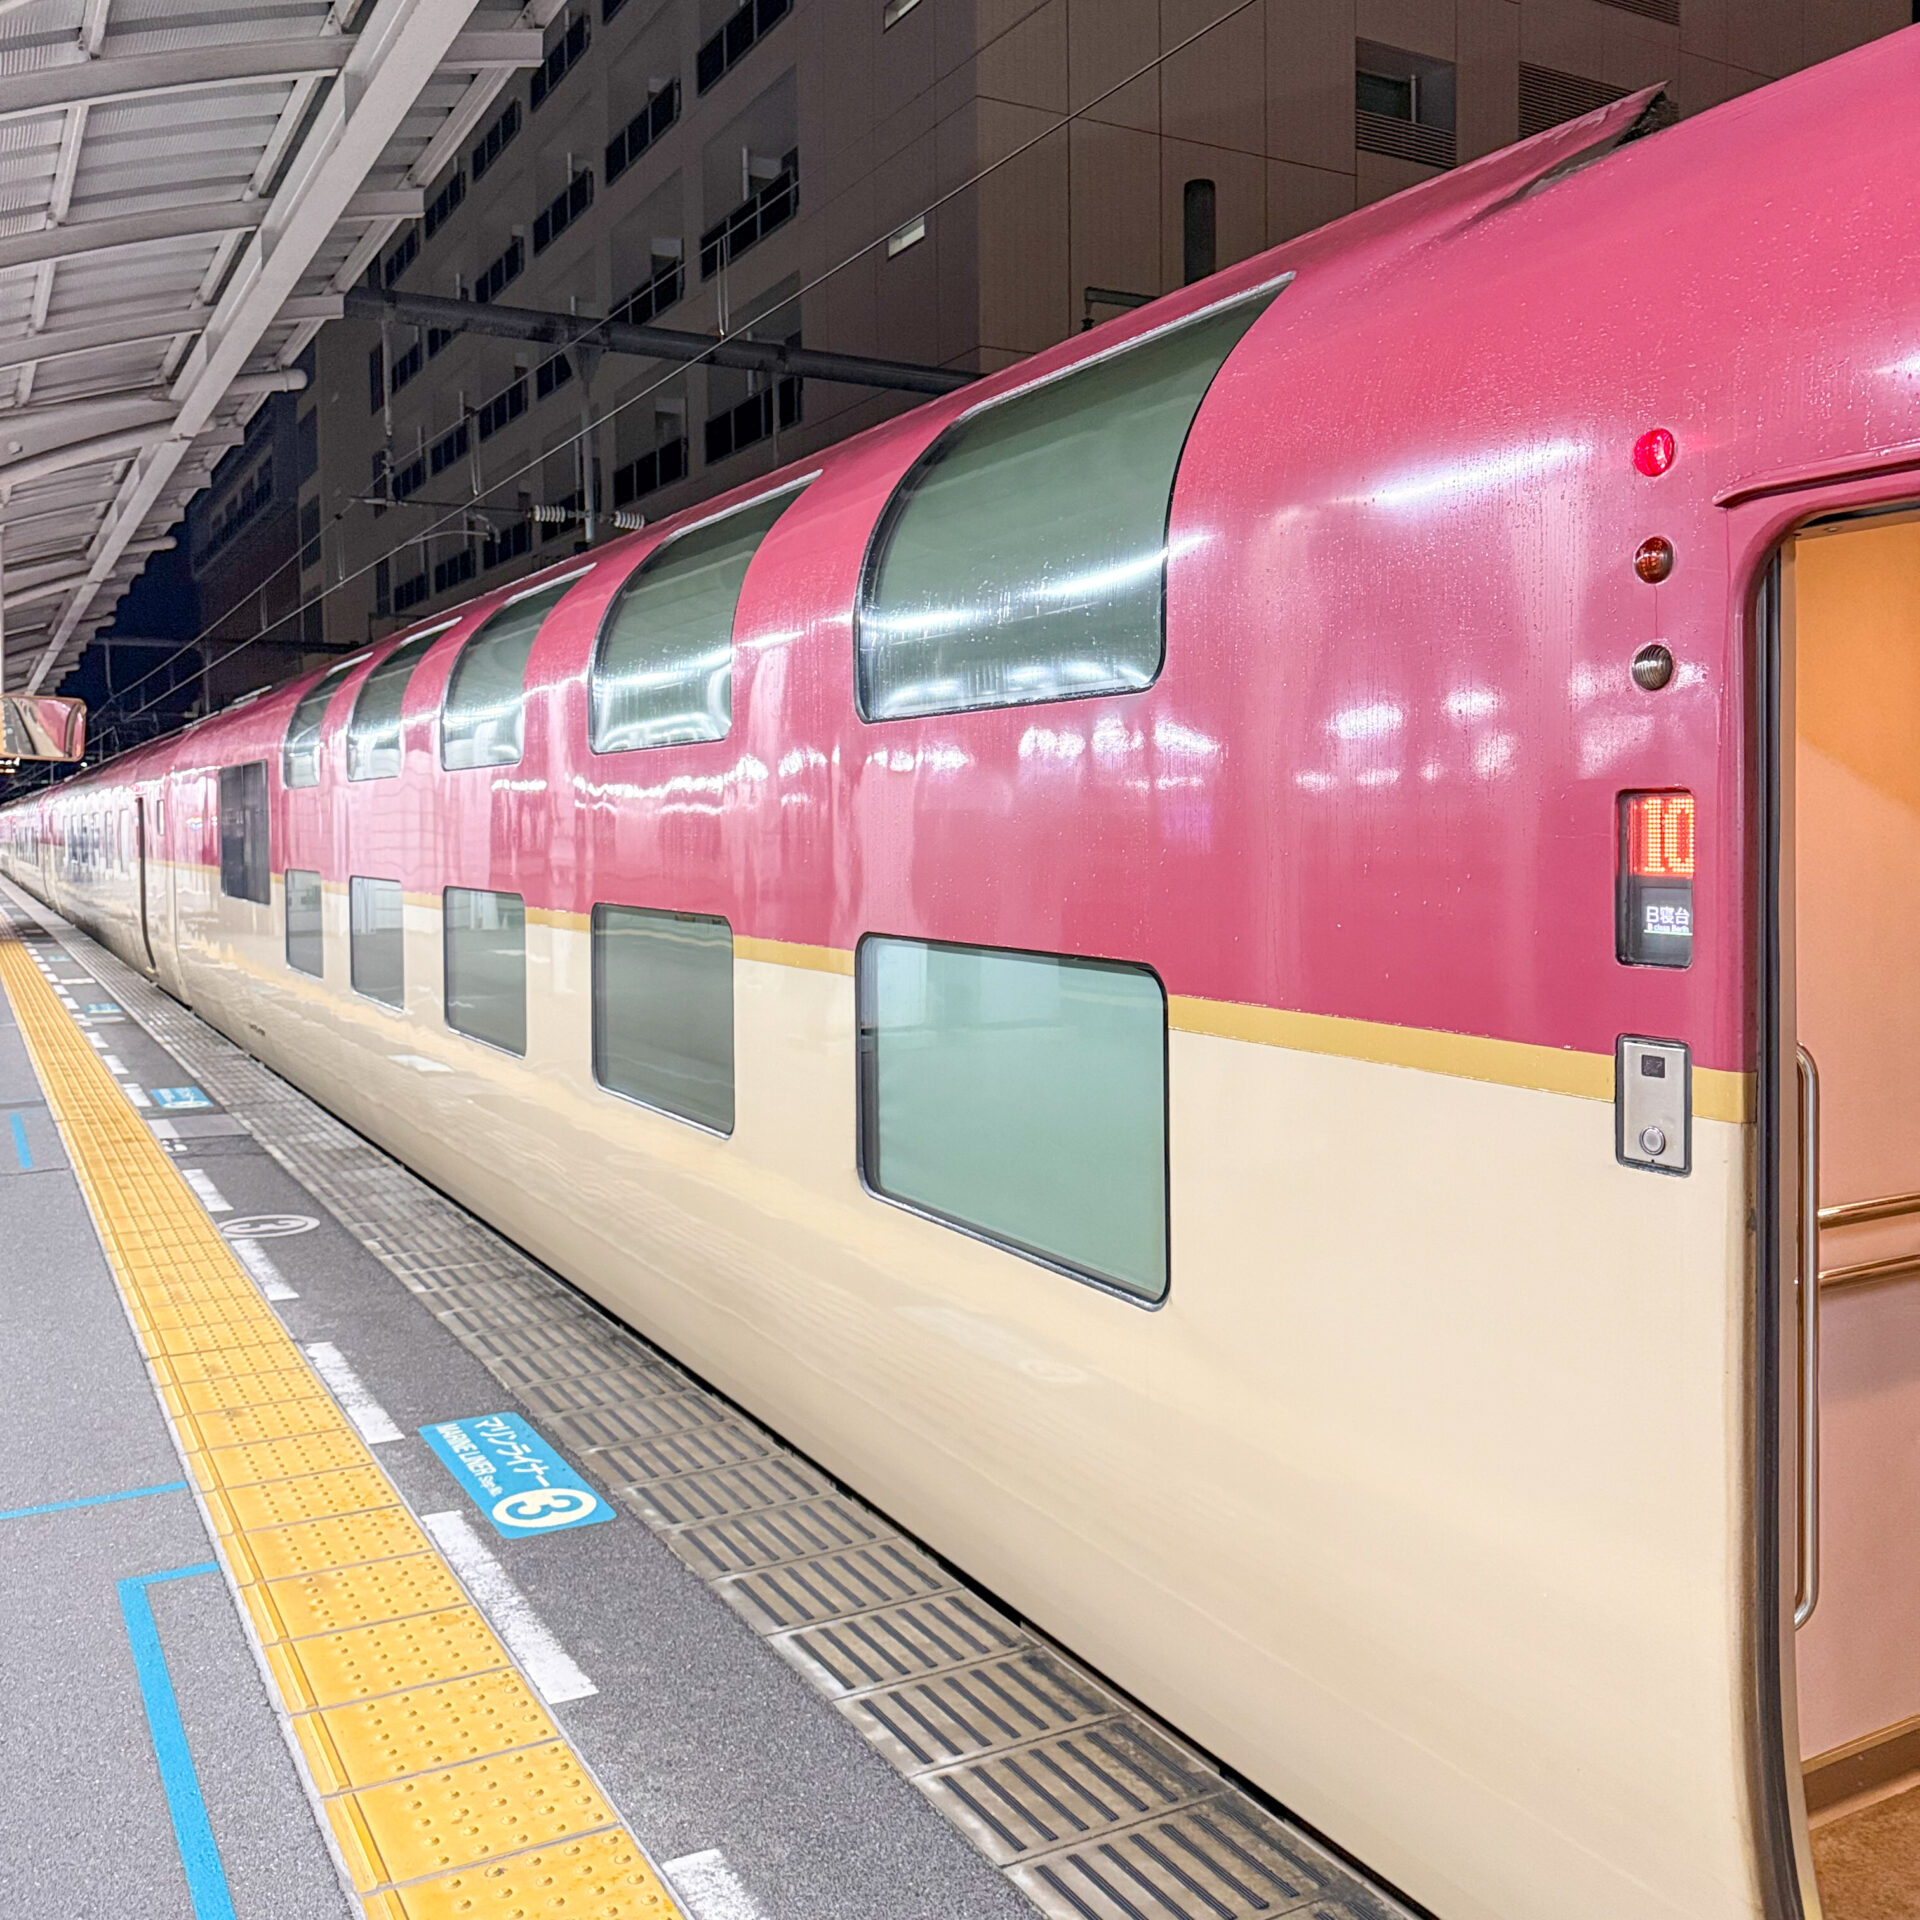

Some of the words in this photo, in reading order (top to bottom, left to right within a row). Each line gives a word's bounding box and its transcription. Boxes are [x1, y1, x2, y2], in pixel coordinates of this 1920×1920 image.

[1644, 798, 1694, 872] 10
[1646, 905, 1690, 925] B寝台
[435, 1423, 478, 1454] MARINE
[459, 1450, 497, 1477] LINER
[474, 1416, 550, 1488] マリンライナー
[504, 1494, 584, 1521] 3
